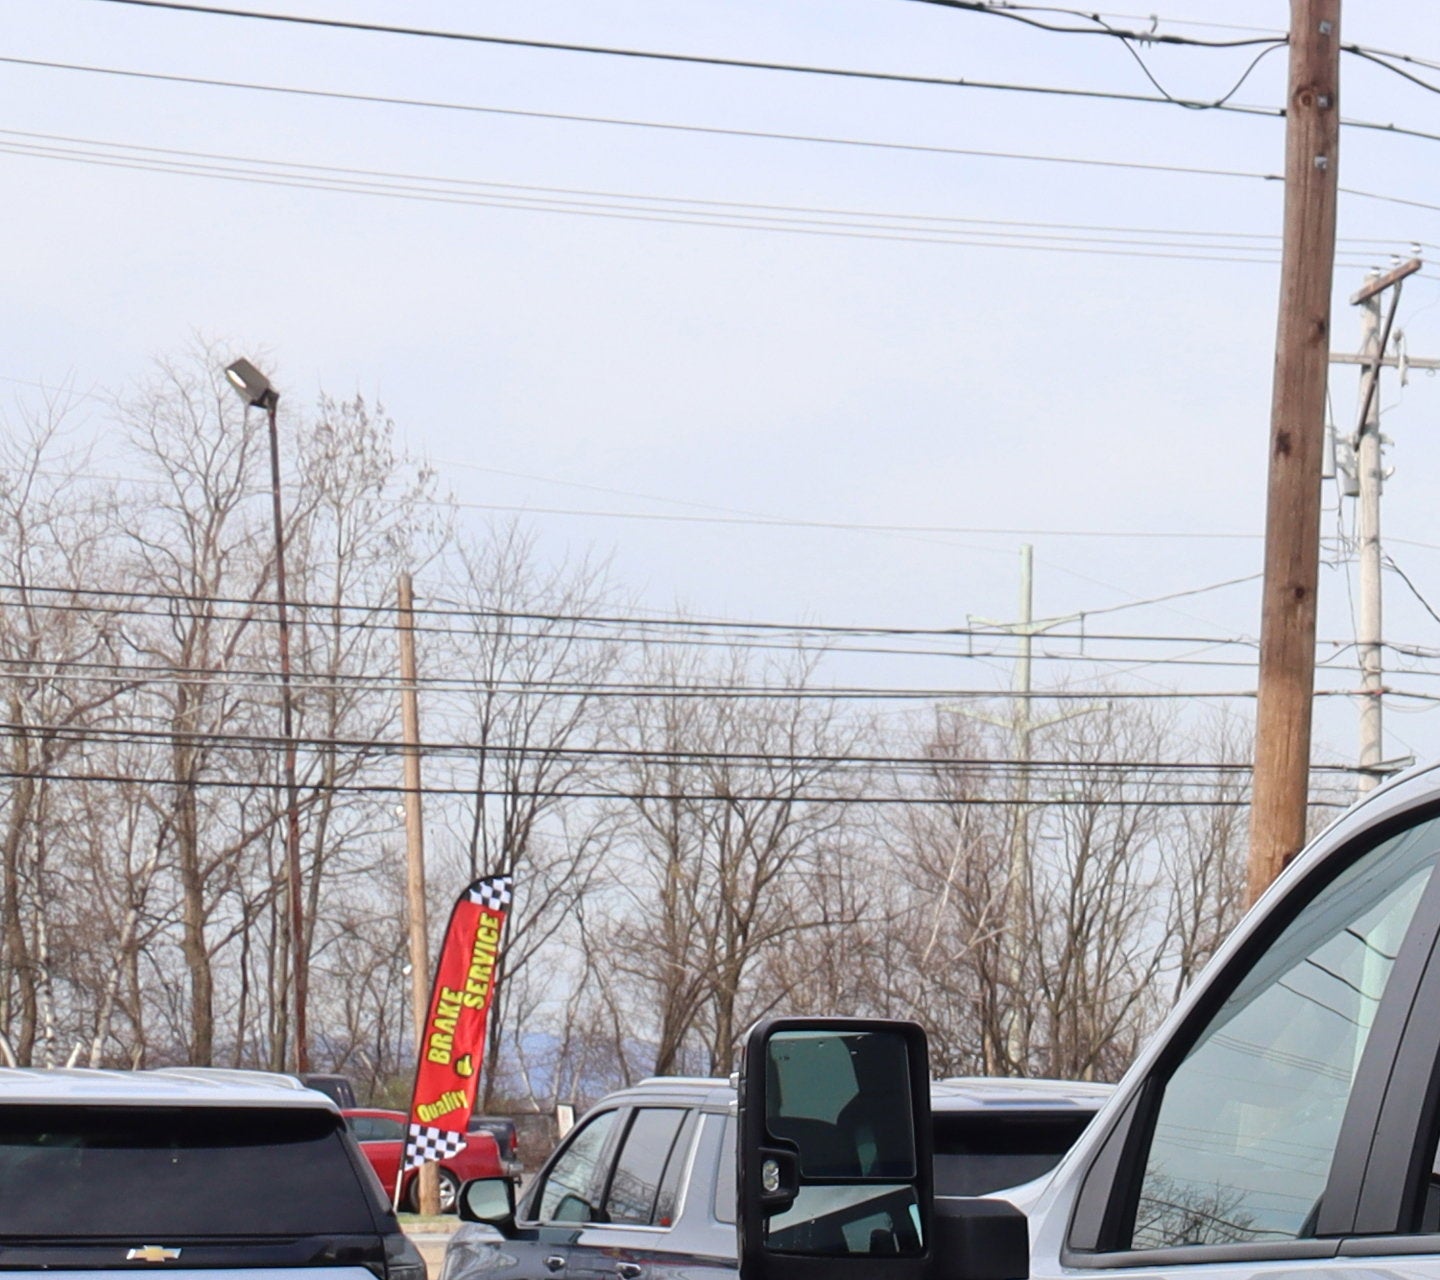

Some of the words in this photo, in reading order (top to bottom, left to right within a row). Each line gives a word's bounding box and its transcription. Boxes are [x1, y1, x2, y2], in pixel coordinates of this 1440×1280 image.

[463, 912, 499, 1010] SERVICE
[427, 986, 464, 1066] BRAKE
[416, 1089, 468, 1124] Quality
